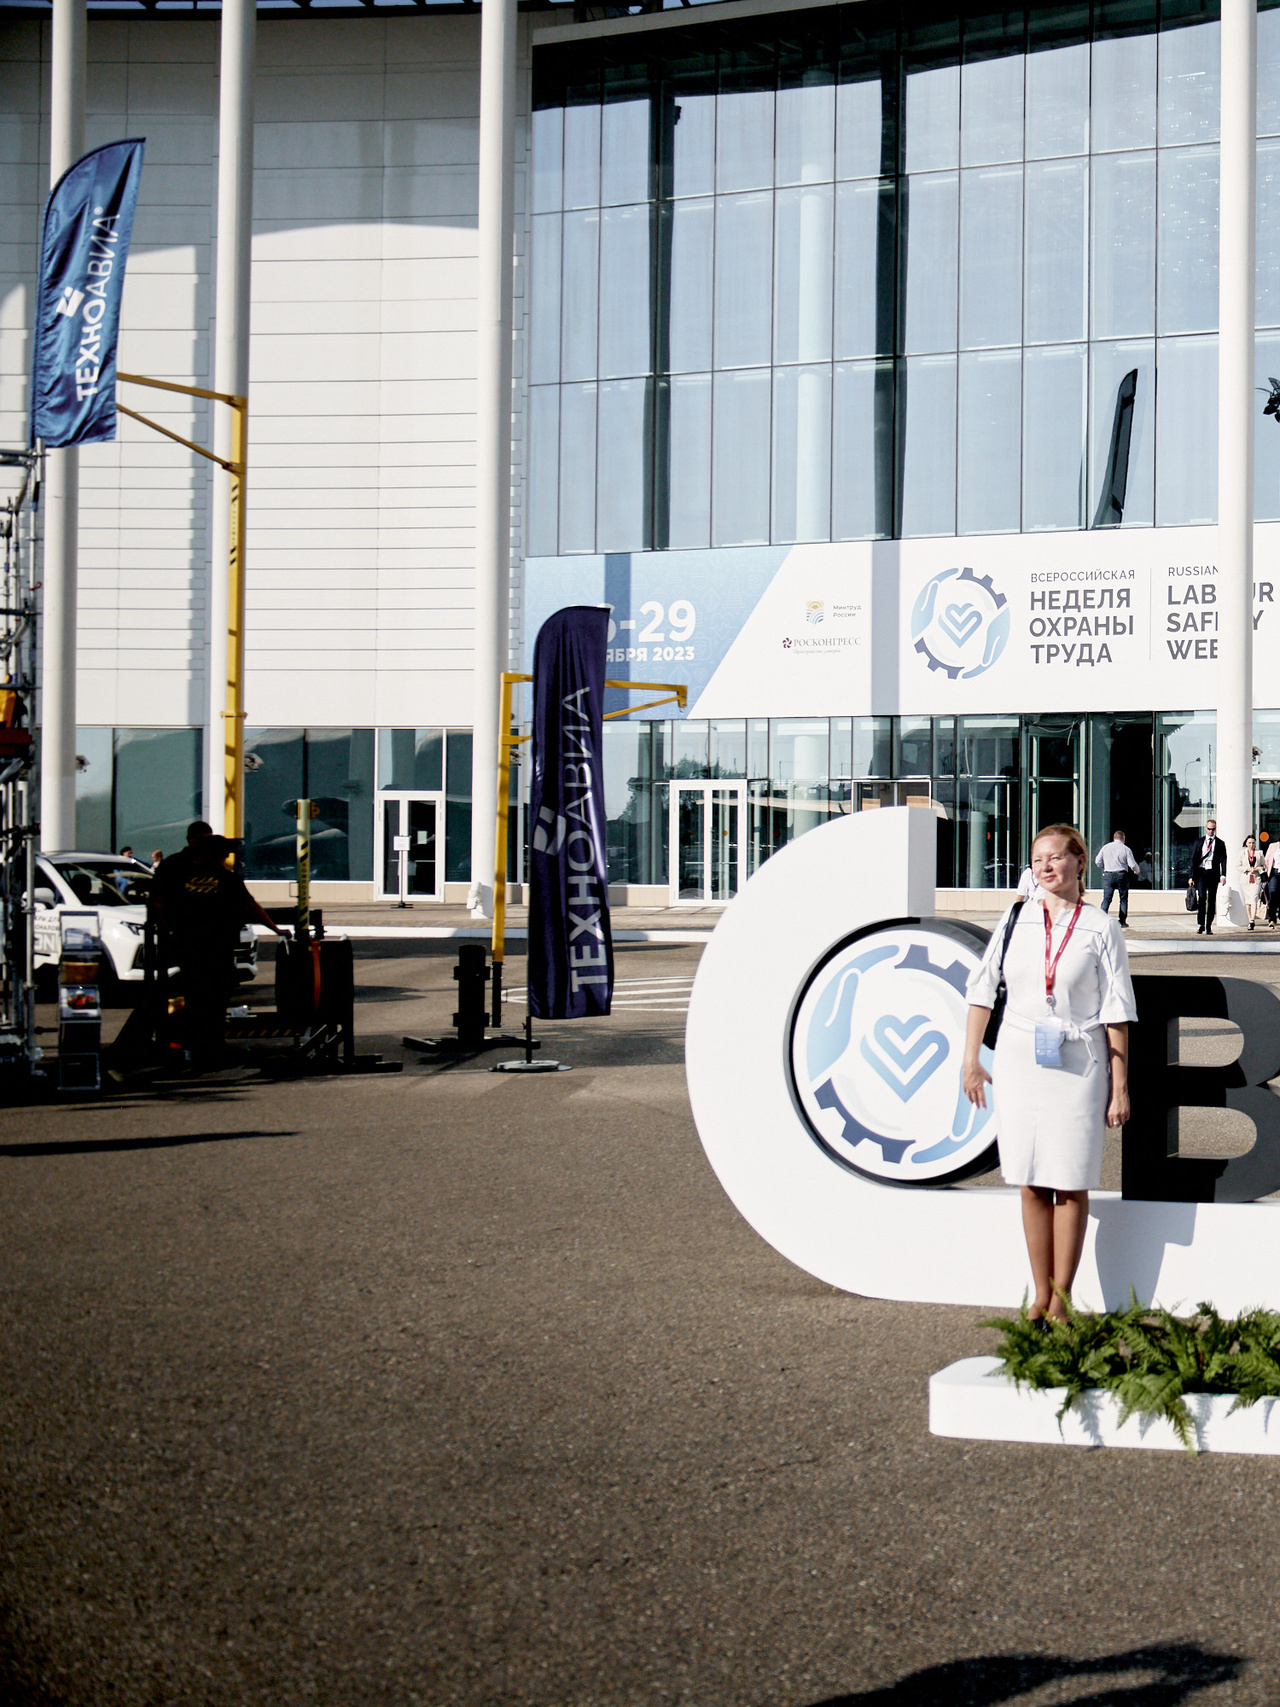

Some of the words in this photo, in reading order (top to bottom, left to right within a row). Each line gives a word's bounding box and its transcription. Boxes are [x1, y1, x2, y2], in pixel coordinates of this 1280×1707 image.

[1030, 569, 1135, 583] ВСЕРОССИЙСКАЯ
[1030, 588, 1131, 613] НЕДЕЛЯ
[1168, 582, 1274, 605] LABR
[1029, 615, 1134, 637] ОХРАНЫ
[1166, 610, 1264, 633] SAFY
[793, 637, 861, 647] РОСКОНГРЕСС
[1166, 639, 1219, 660] WEE
[652, 646, 695, 661] 2023
[1030, 643, 1113, 667] ТРУДА
[562, 685, 607, 993] ТЕХНОАВИА
